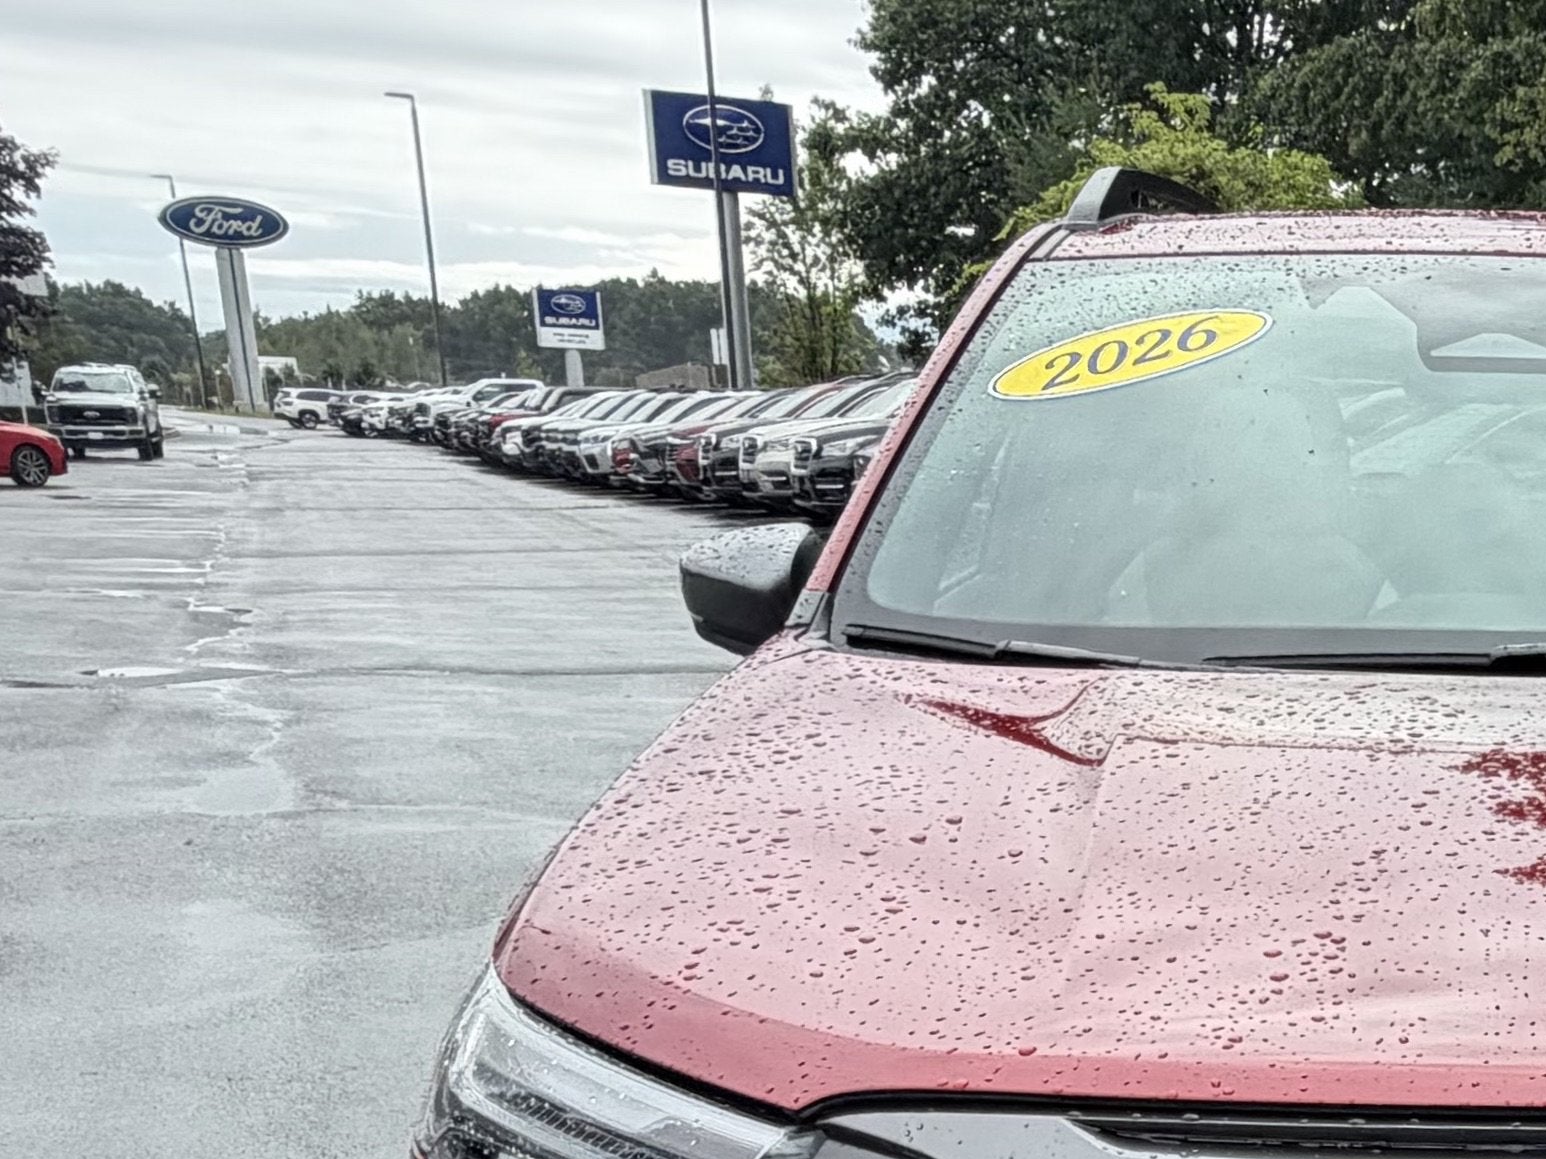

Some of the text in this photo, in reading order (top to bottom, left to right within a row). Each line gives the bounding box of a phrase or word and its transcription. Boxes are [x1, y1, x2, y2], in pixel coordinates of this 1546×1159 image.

[666, 158, 785, 186] SUBARU
[188, 203, 264, 237] Ford
[1040, 315, 1221, 392] 2026
